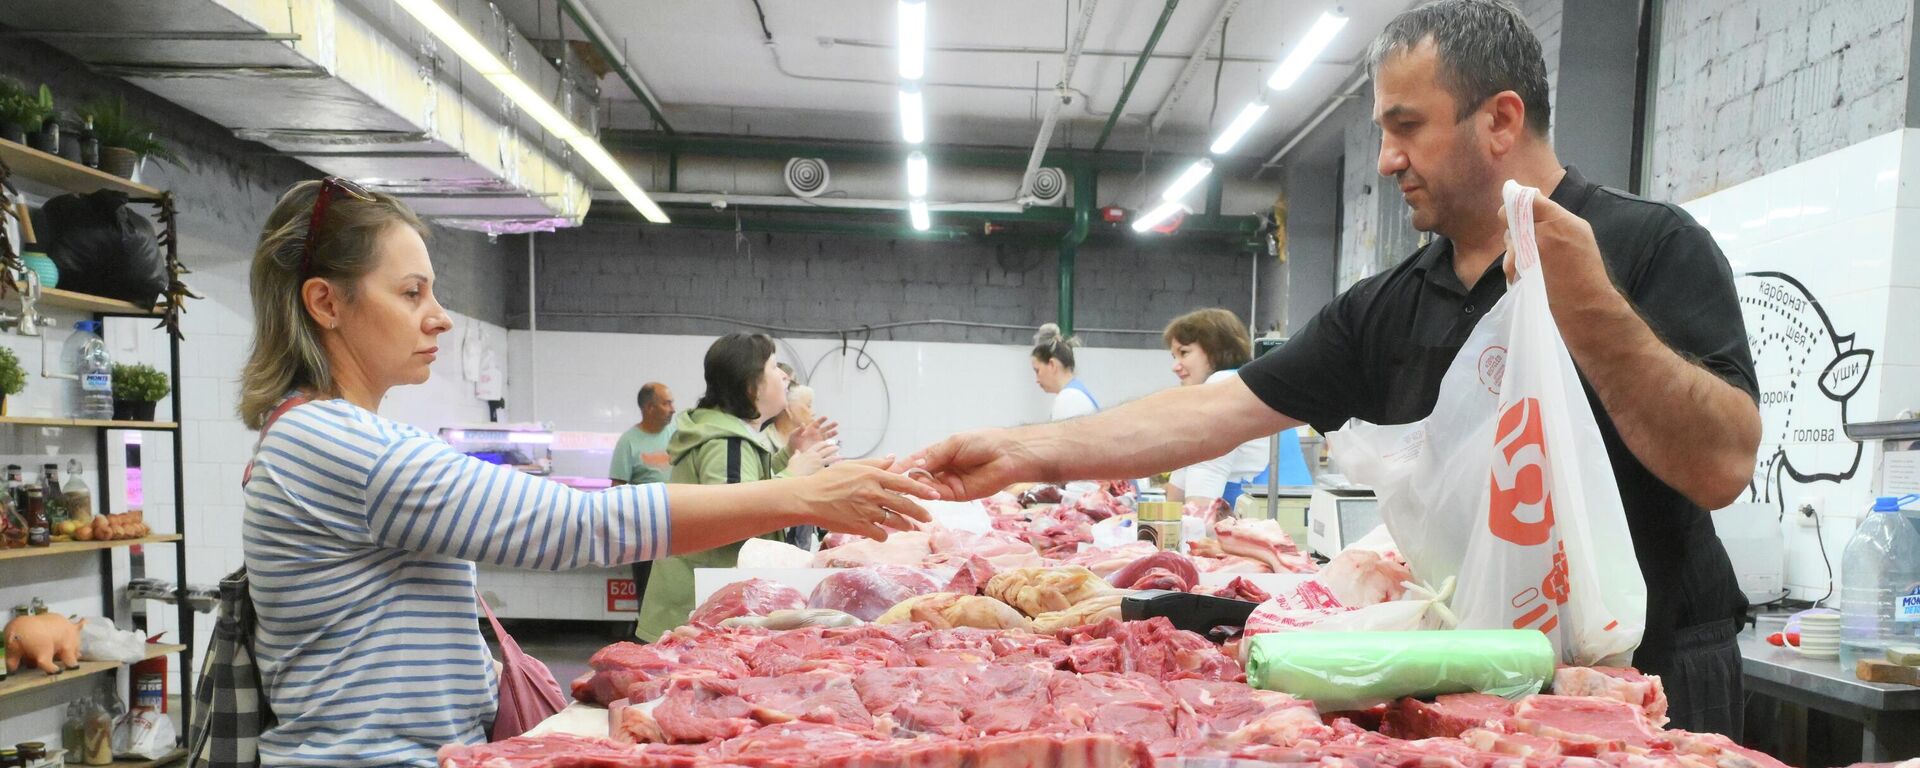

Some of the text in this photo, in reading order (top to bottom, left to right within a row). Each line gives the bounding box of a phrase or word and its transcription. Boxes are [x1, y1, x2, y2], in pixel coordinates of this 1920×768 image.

[1759, 281, 1808, 314] карбонат
[1786, 325, 1807, 347] шея
[1832, 362, 1859, 389] уши
[1793, 428, 1835, 442] голова
[610, 582, 636, 595] Б20
